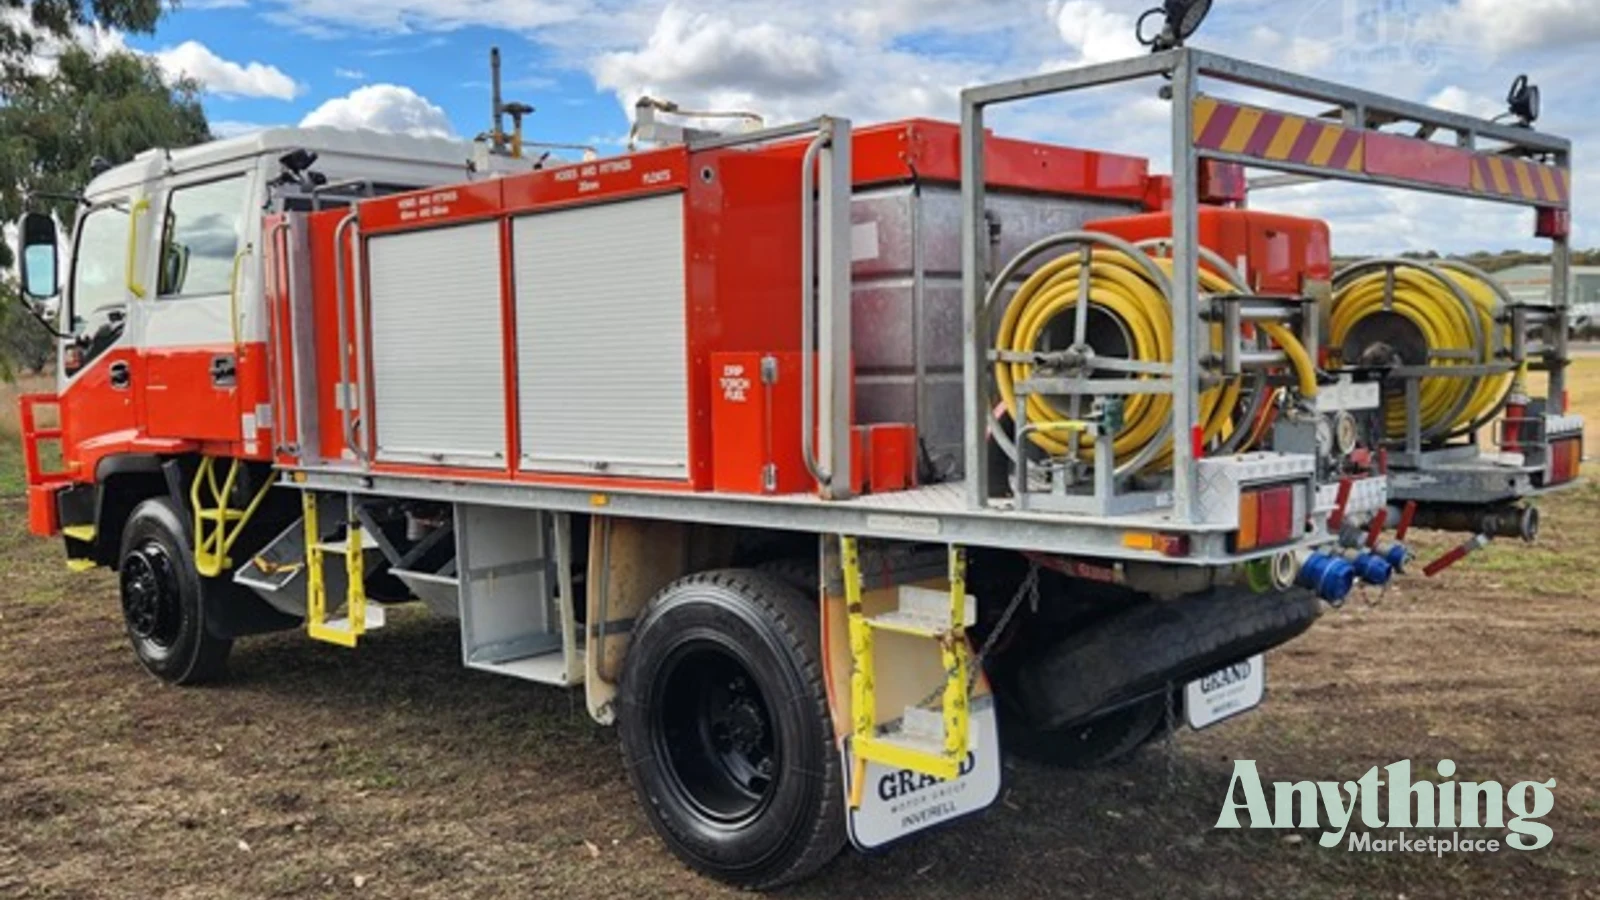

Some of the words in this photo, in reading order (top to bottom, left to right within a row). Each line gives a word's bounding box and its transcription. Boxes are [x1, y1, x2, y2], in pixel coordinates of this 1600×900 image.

[720, 377, 750, 389] TORCH
[878, 751, 975, 801] GRAD
[902, 801, 957, 828] INVERELL
